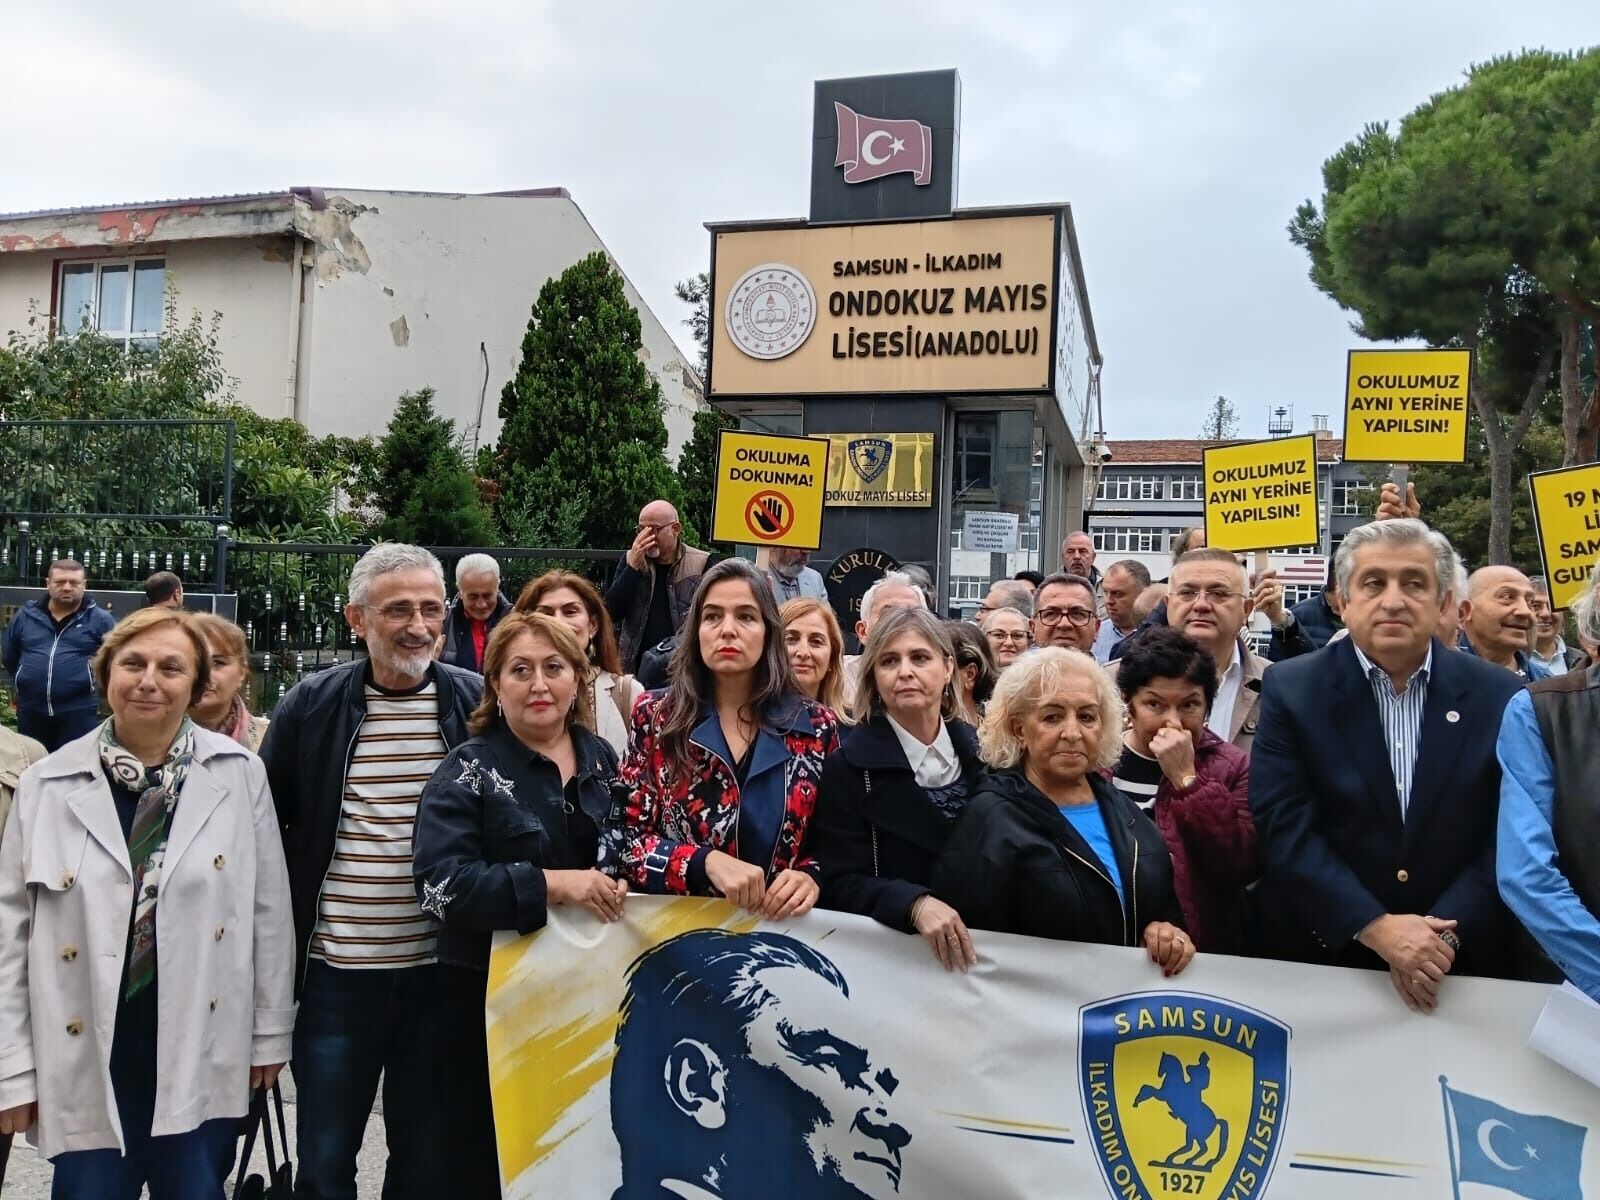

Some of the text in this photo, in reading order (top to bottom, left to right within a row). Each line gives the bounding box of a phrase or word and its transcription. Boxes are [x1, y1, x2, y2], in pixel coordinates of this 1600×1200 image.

[833, 257, 908, 277] SAMSUN
[925, 252, 1002, 273] İLKADIM
[829, 287, 955, 317] ONDOKUZ
[964, 284, 1048, 313] MAYIS
[1357, 374, 1460, 389] OKULUMUZ
[1351, 393, 1464, 411] AYNI YERİNE
[1363, 418, 1449, 433] YAPILSIN!
[736, 448, 811, 468] OKULUMA
[729, 467, 813, 487] DOKUNMA!
[1213, 460, 1306, 483] OKULUMUZ
[825, 488, 927, 502] DOKUZ MAYIS LİSESİ
[1209, 480, 1312, 505] AYNI YERİNE
[1563, 490, 1586, 508] 19
[1221, 503, 1300, 524] YAPILSIN!
[1584, 509, 1600, 530] Lİ
[1560, 538, 1600, 559] SAM
[849, 597, 863, 612] 19
[1114, 1006, 1258, 1050] SAMSUN
[1088, 1062, 1142, 1200] İLKADIM ON
[1247, 1079, 1279, 1168] LİSESİ
[1160, 1171, 1206, 1195] 1927
